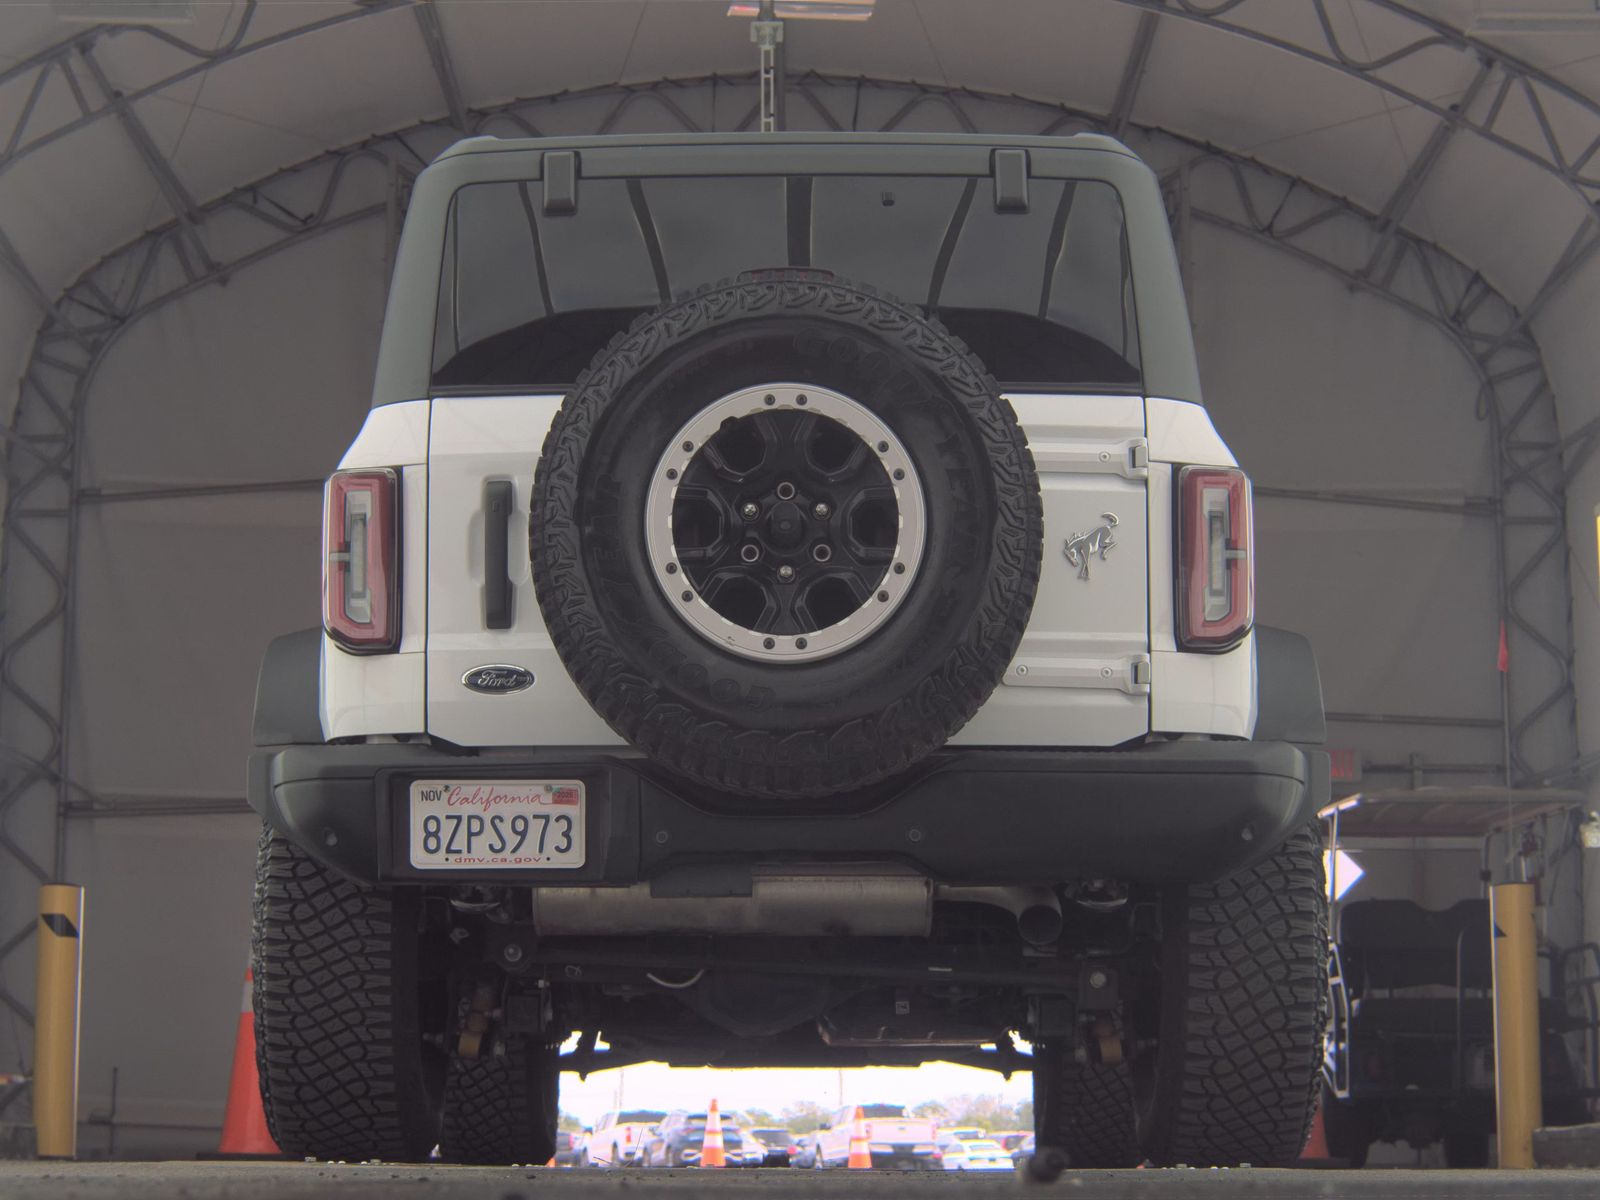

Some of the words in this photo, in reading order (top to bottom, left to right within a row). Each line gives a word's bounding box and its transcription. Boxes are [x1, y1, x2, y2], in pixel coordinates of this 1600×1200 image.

[477, 669, 518, 687] Ford
[420, 790, 442, 802] NOV
[447, 784, 553, 812] California
[422, 814, 574, 855] 8ZPS973
[454, 856, 542, 865] dmv.ca.gov
